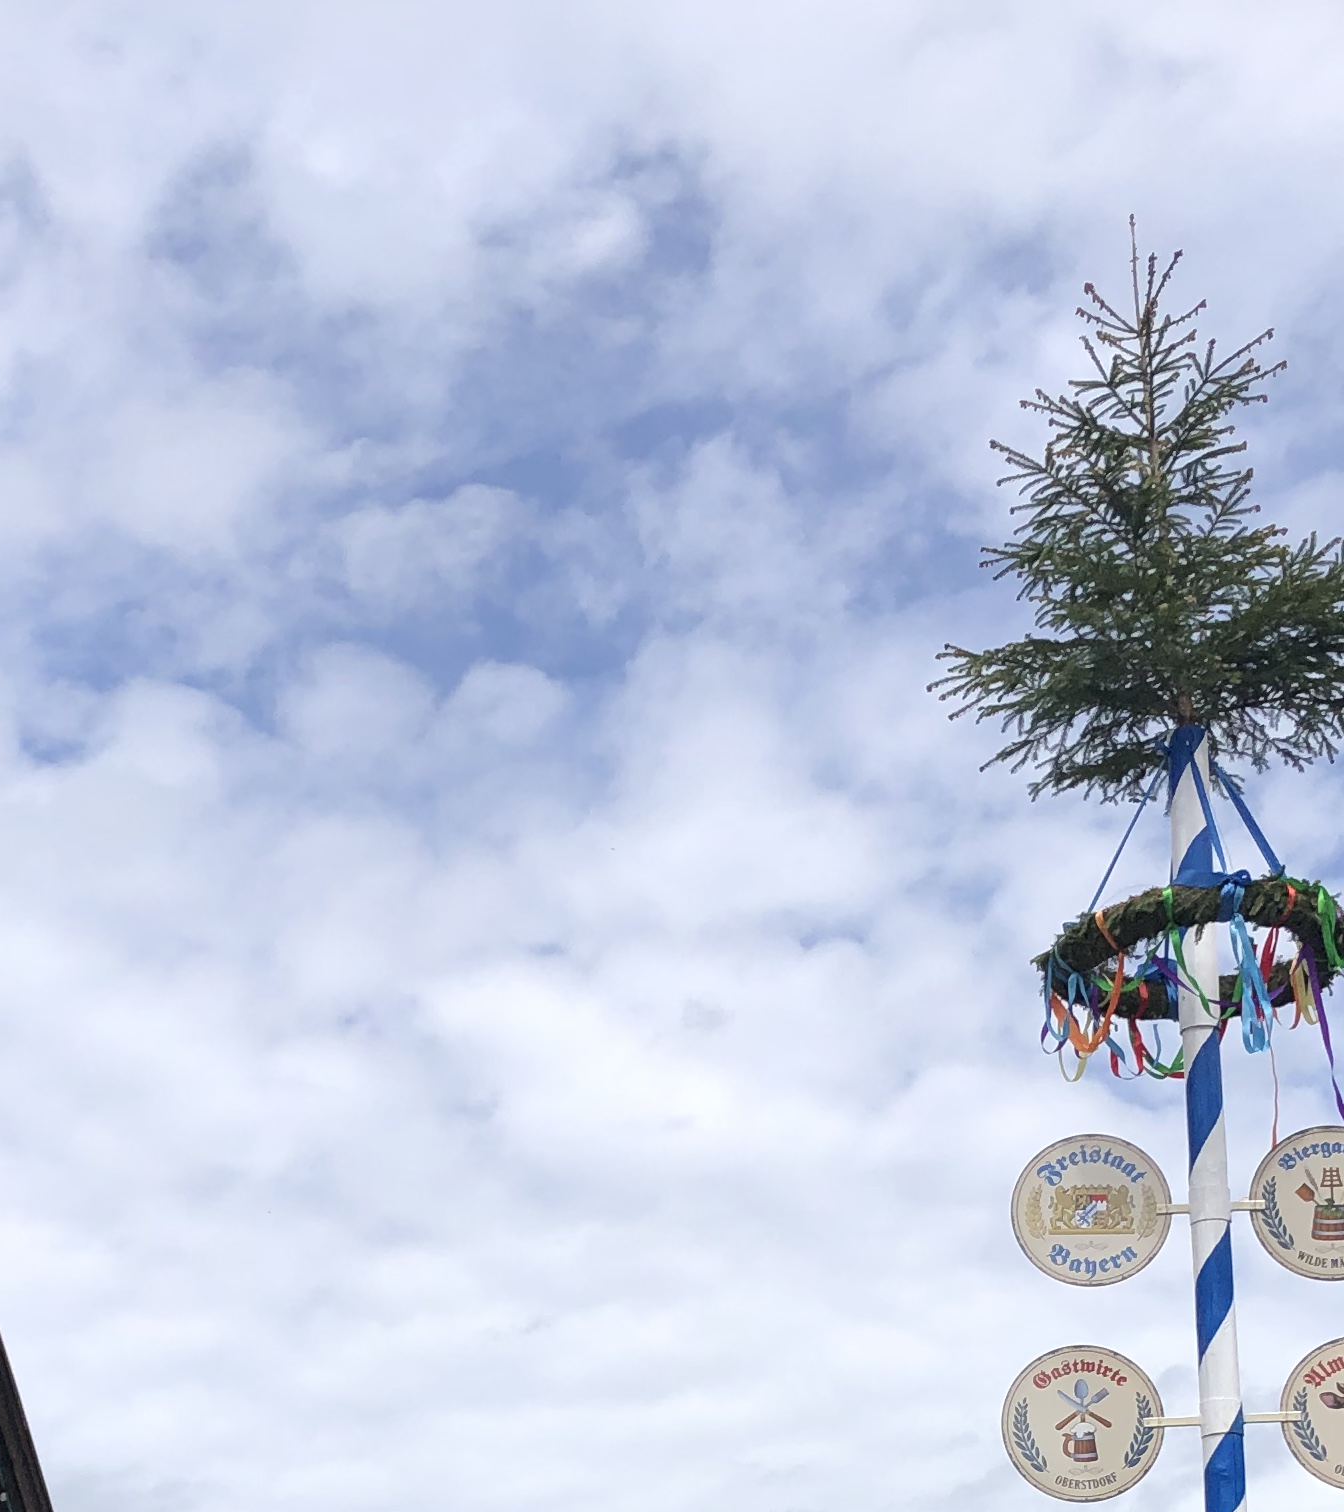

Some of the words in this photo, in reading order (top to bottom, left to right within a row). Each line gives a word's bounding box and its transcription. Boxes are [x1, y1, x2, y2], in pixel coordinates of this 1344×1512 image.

[1036, 1144, 1148, 1186] Freistaat
[1047, 1243, 1138, 1280] Bayern
[1297, 1250, 1328, 1268] WILDE
[1033, 1358, 1128, 1389] Gastwirte
[1055, 1472, 1118, 1490] OBERSTDORF
